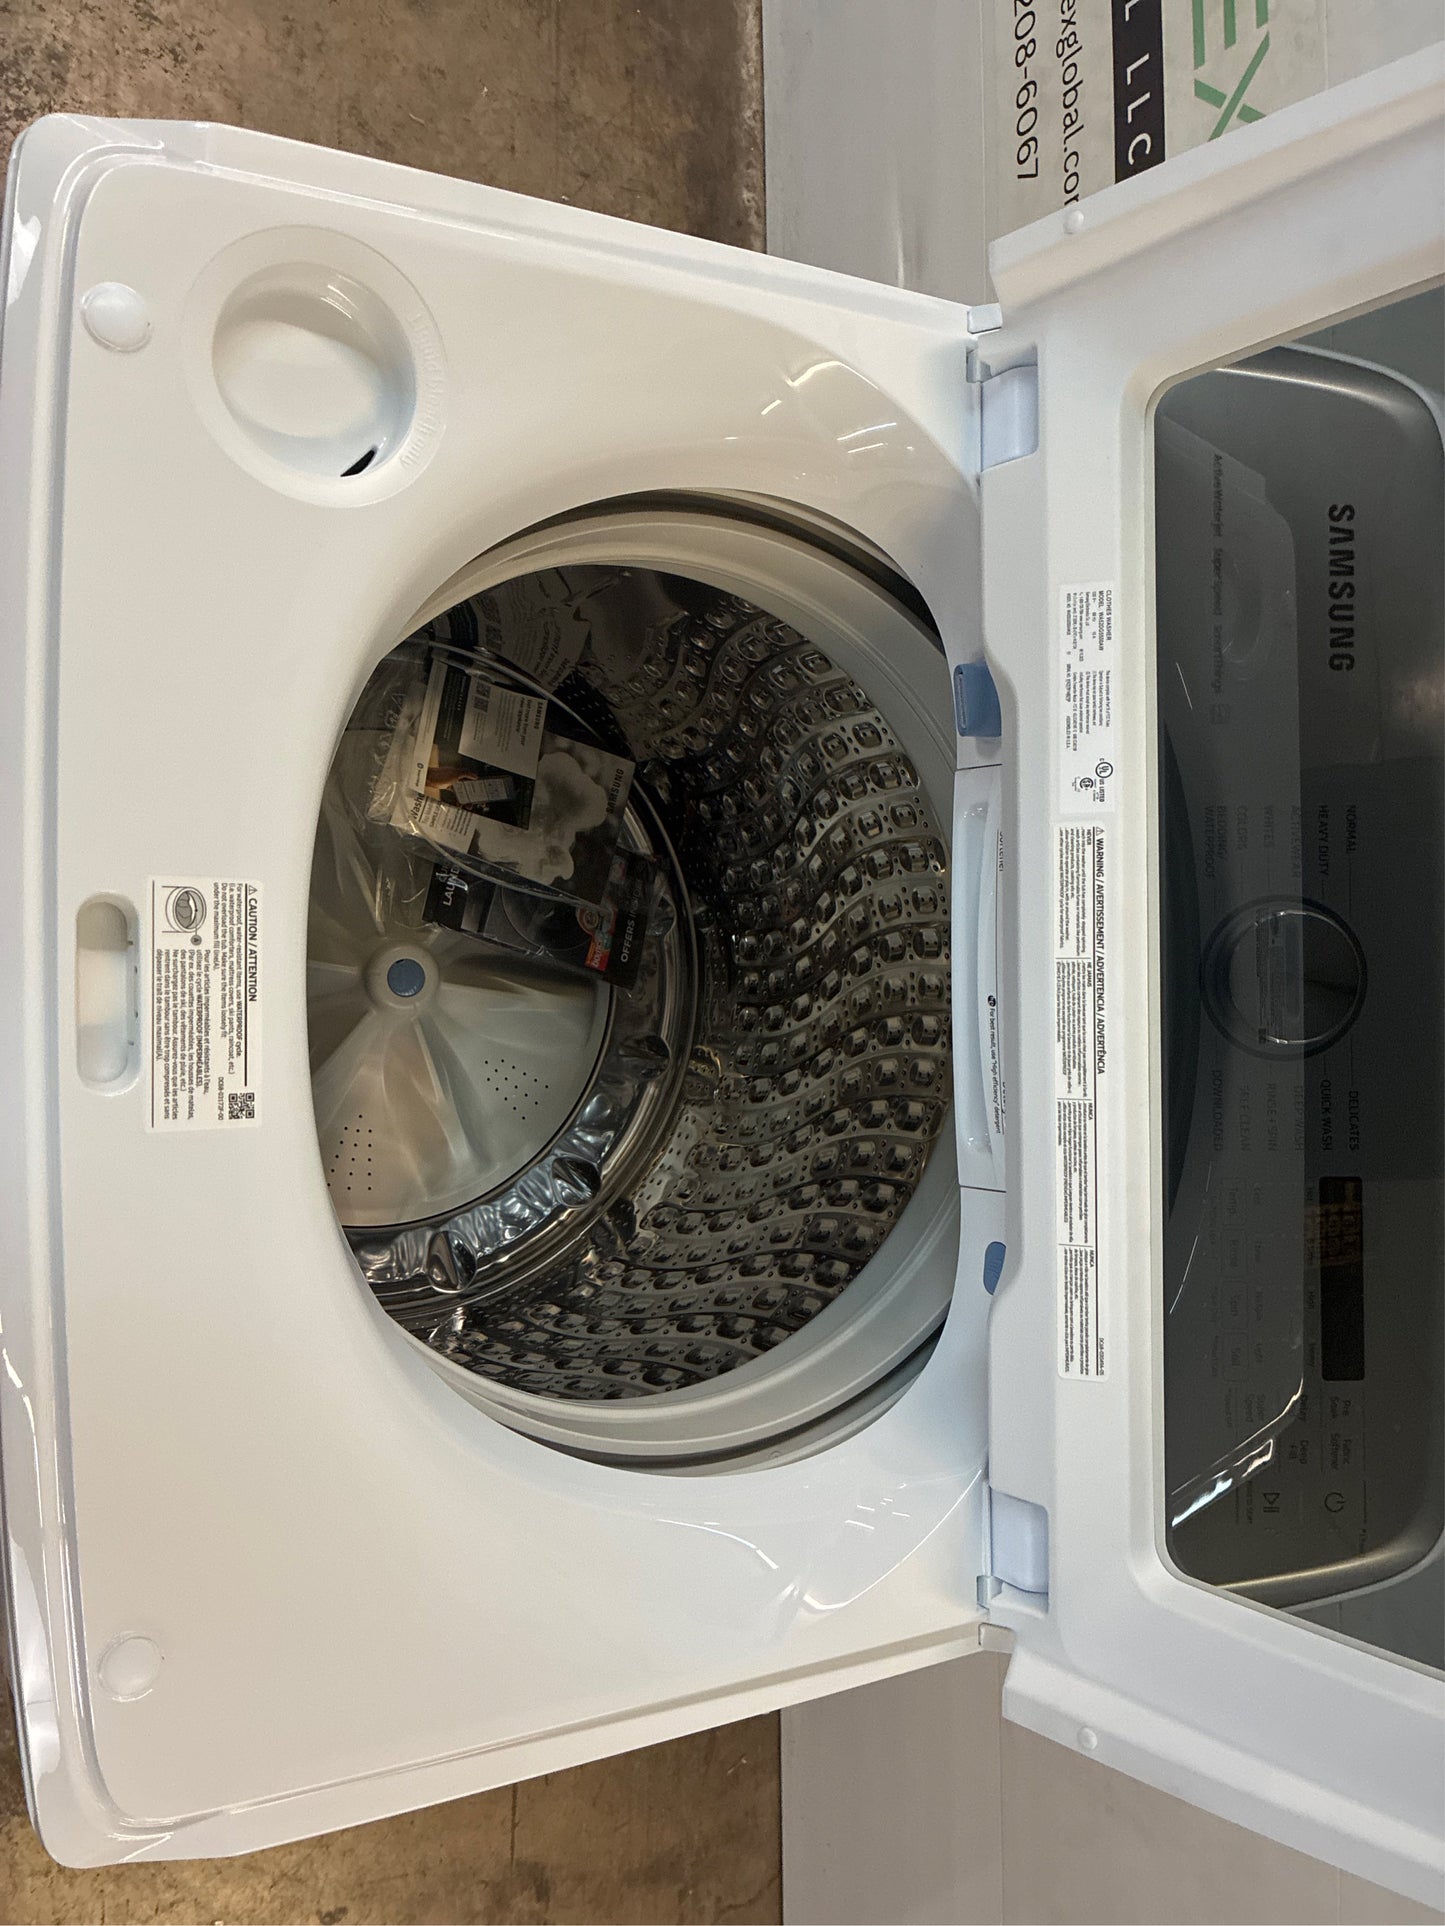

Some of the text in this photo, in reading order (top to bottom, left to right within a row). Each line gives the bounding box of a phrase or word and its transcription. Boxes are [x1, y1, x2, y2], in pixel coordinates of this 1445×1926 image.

[1125, 52, 1152, 166] LLC
[1328, 504, 1356, 671] SAMSUNG
[605, 768, 626, 816] SAMSUNG
[1204, 805, 1215, 880] WATERPROOF
[1237, 805, 1248, 850] COLORS
[1264, 805, 1274, 848] WHITES
[1318, 804, 1329, 876] HEAVY DUTY
[1346, 804, 1356, 854] NORMAL
[1096, 838, 1104, 877] WARNING
[221, 883, 227, 891] Do
[443, 862, 461, 906] LAUND
[248, 898, 257, 940] CAUTION
[620, 918, 638, 963] OFFERS
[1096, 884, 1104, 949] AVERTISSEMENT
[172, 949, 178, 958] Ne
[248, 949, 257, 1002] ATTENTION
[1096, 956, 1104, 1012] ADVERTENCIA
[1097, 1018, 1106, 1074] ADVERTÊNCIA
[991, 1077, 999, 1106] efficiency"
[1212, 1070, 1224, 1152] DOWNLOADED
[1320, 1079, 1332, 1151] QUICK WASH
[992, 1106, 1000, 1134] detergent
[1348, 1090, 1360, 1151] DELICATES
